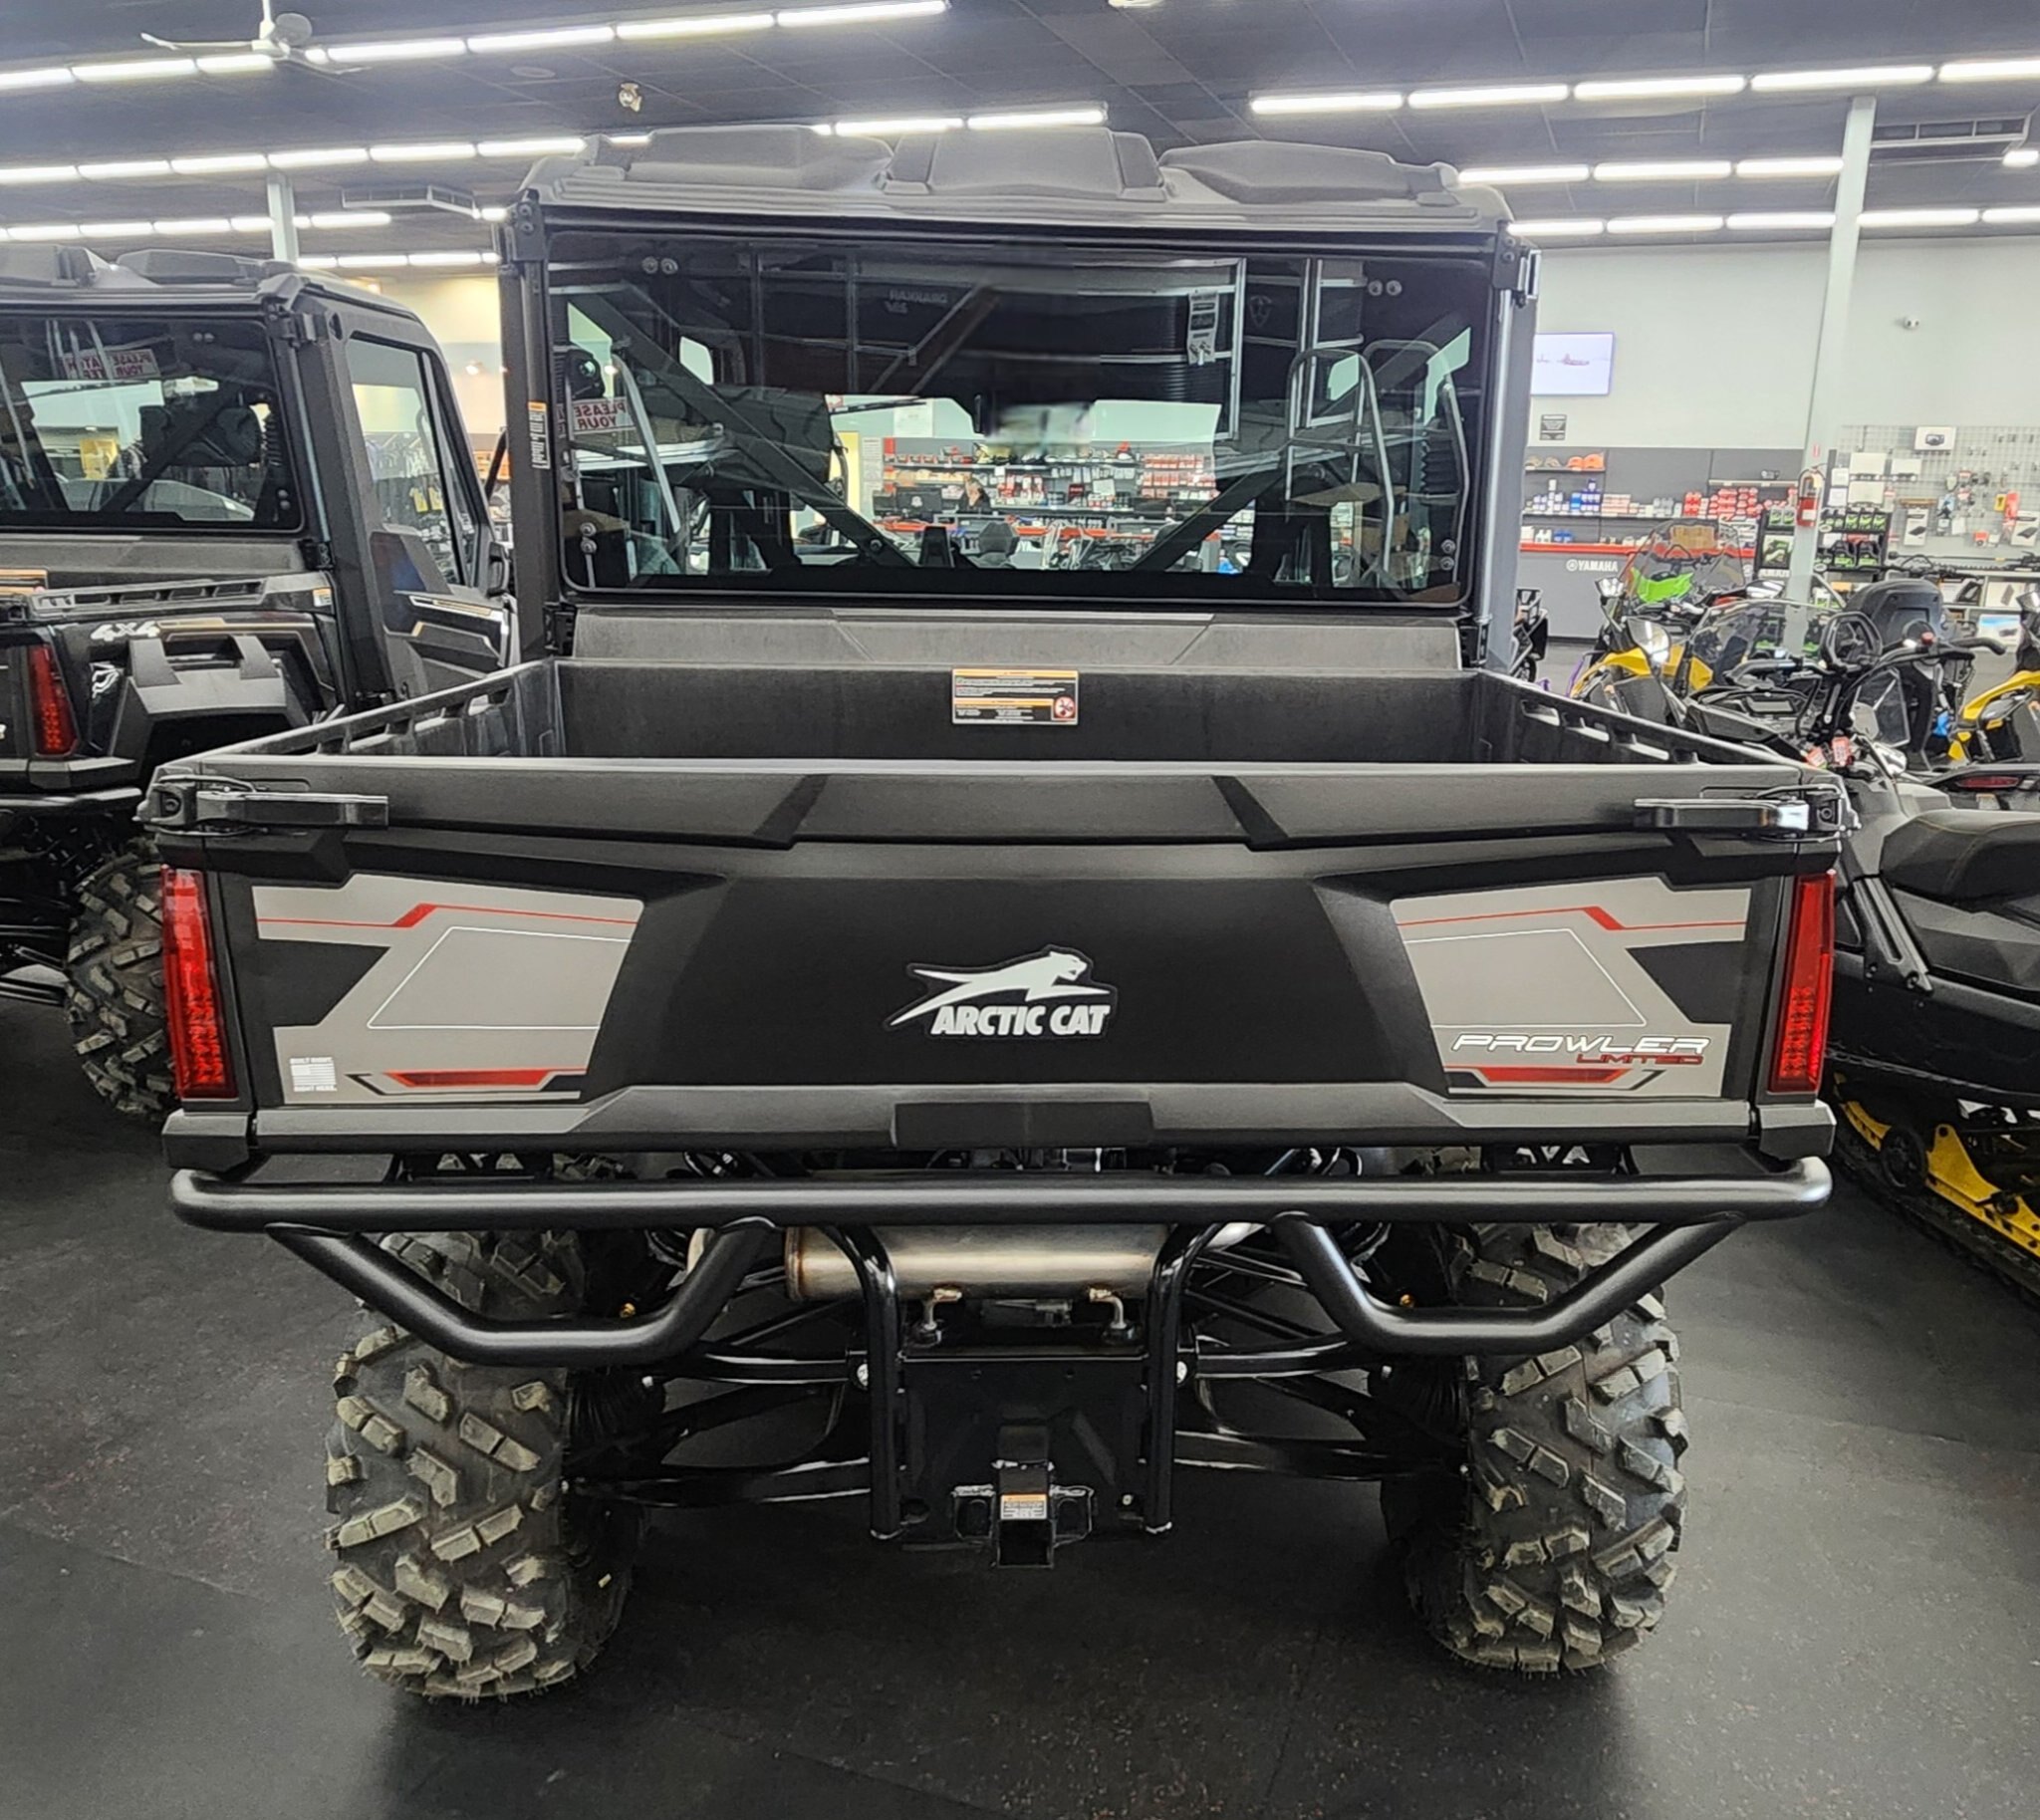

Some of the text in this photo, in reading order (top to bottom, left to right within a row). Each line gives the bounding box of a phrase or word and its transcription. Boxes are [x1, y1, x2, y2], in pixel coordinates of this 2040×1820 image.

[1577, 560, 1619, 572] YAMAHA
[930, 1005, 1111, 1035] ARCTIC CAT
[1452, 1034, 1711, 1054] PROWLER
[1577, 1054, 1704, 1065] LIMITED
